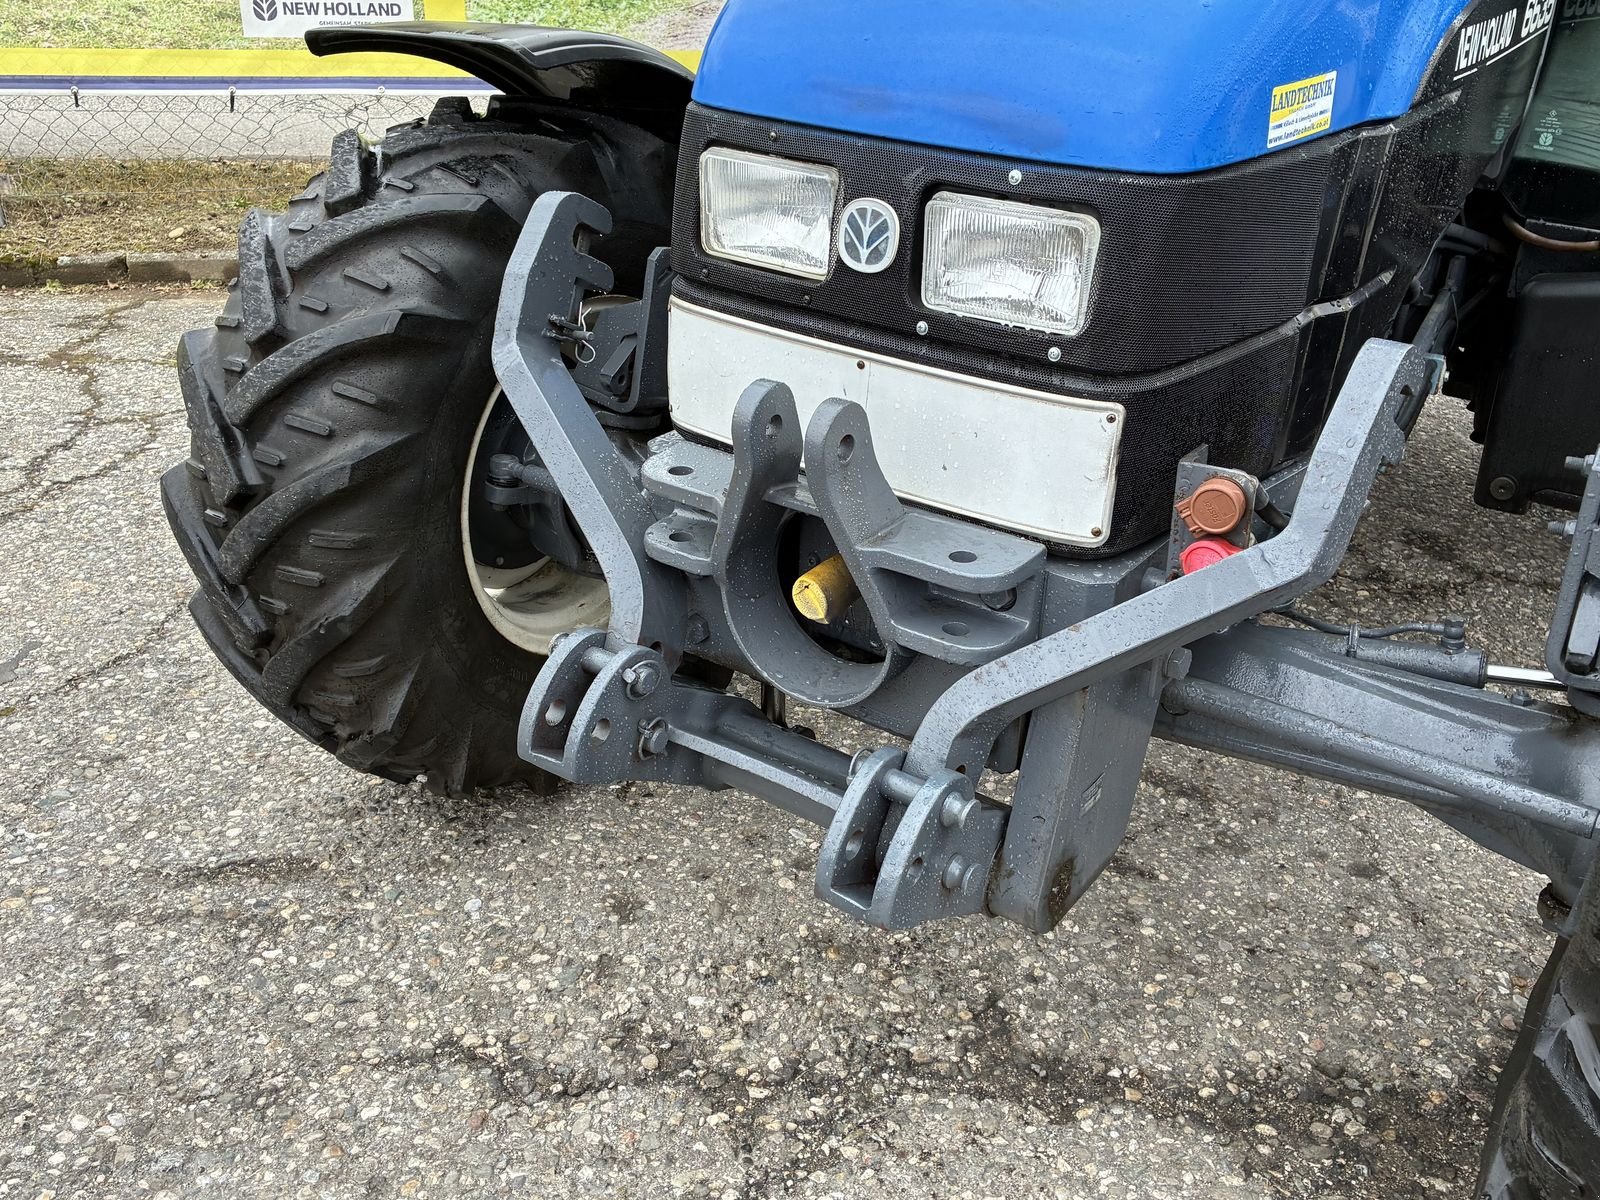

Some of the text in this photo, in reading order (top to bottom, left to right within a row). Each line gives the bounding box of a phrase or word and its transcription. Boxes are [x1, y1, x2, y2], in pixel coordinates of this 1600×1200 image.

[283, 1, 402, 17] NEW HOLLAND
[1520, 0, 1552, 38] 6635
[1454, 8, 1518, 72] NEW HOLLAND
[1272, 78, 1334, 112] LANDTECHNIK
[1268, 118, 1329, 144] www.landtechnik.co.at
